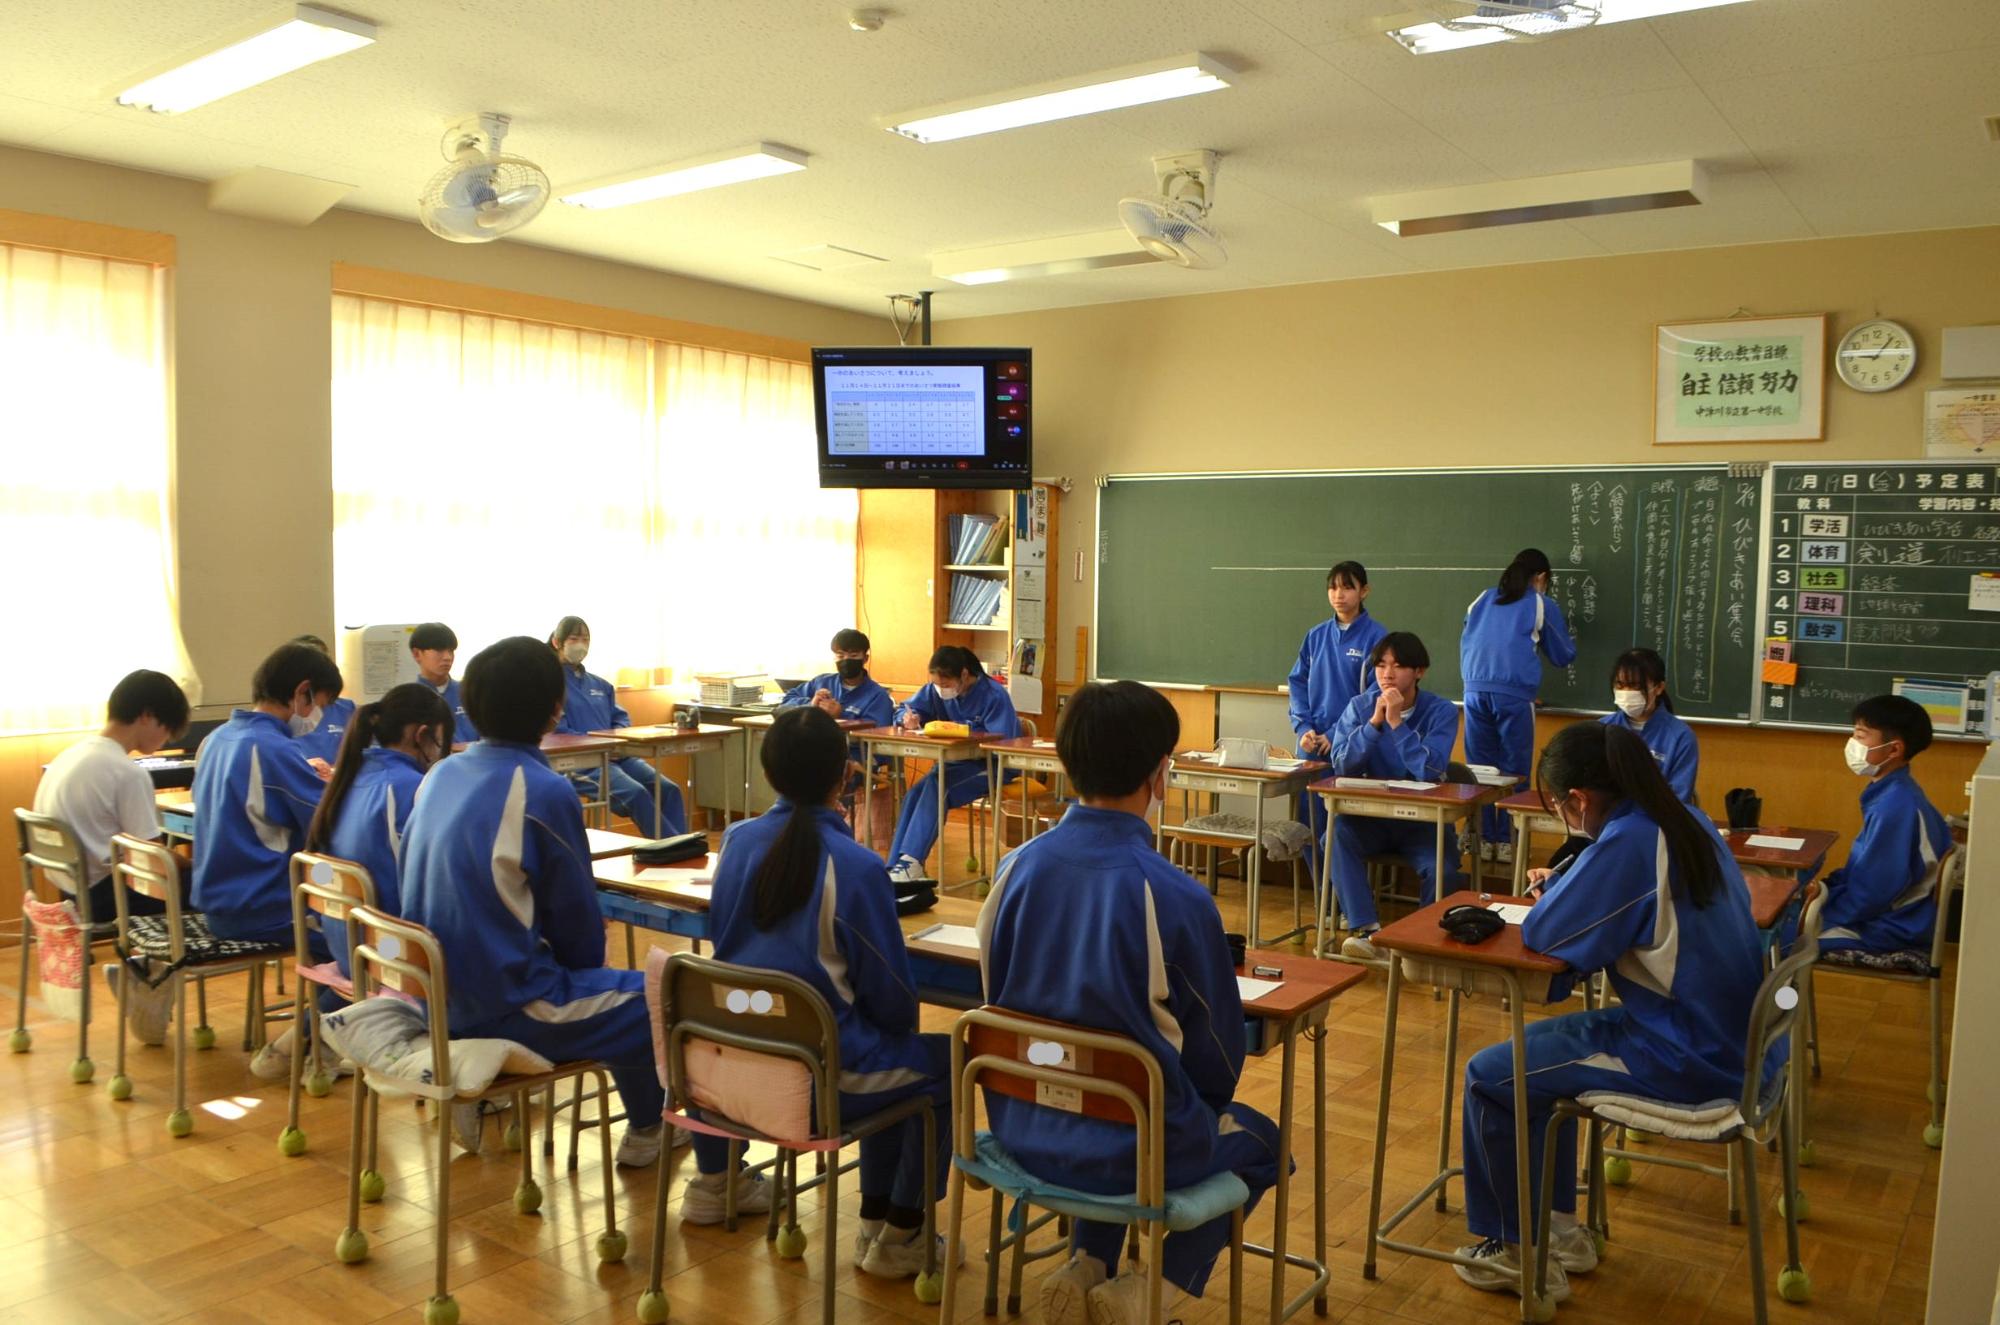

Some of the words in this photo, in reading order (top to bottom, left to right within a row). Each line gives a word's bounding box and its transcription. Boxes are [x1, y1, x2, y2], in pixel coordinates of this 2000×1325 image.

[1682, 372, 1712, 396] 自主
[1718, 373, 1755, 396] 信頼
[1759, 369, 1799, 394] 努力
[1797, 497, 1831, 511] 教科
[1781, 518, 1790, 533] 1
[1809, 519, 1842, 535] 学活
[1777, 544, 1791, 560] 2
[1808, 545, 1840, 561] 体育
[1776, 570, 1790, 585] 3
[1806, 571, 1839, 587] 社会
[1775, 596, 1789, 610] 4
[1804, 597, 1836, 613] 理科
[1774, 621, 1788, 635] 5
[1805, 624, 1837, 639] 数学
